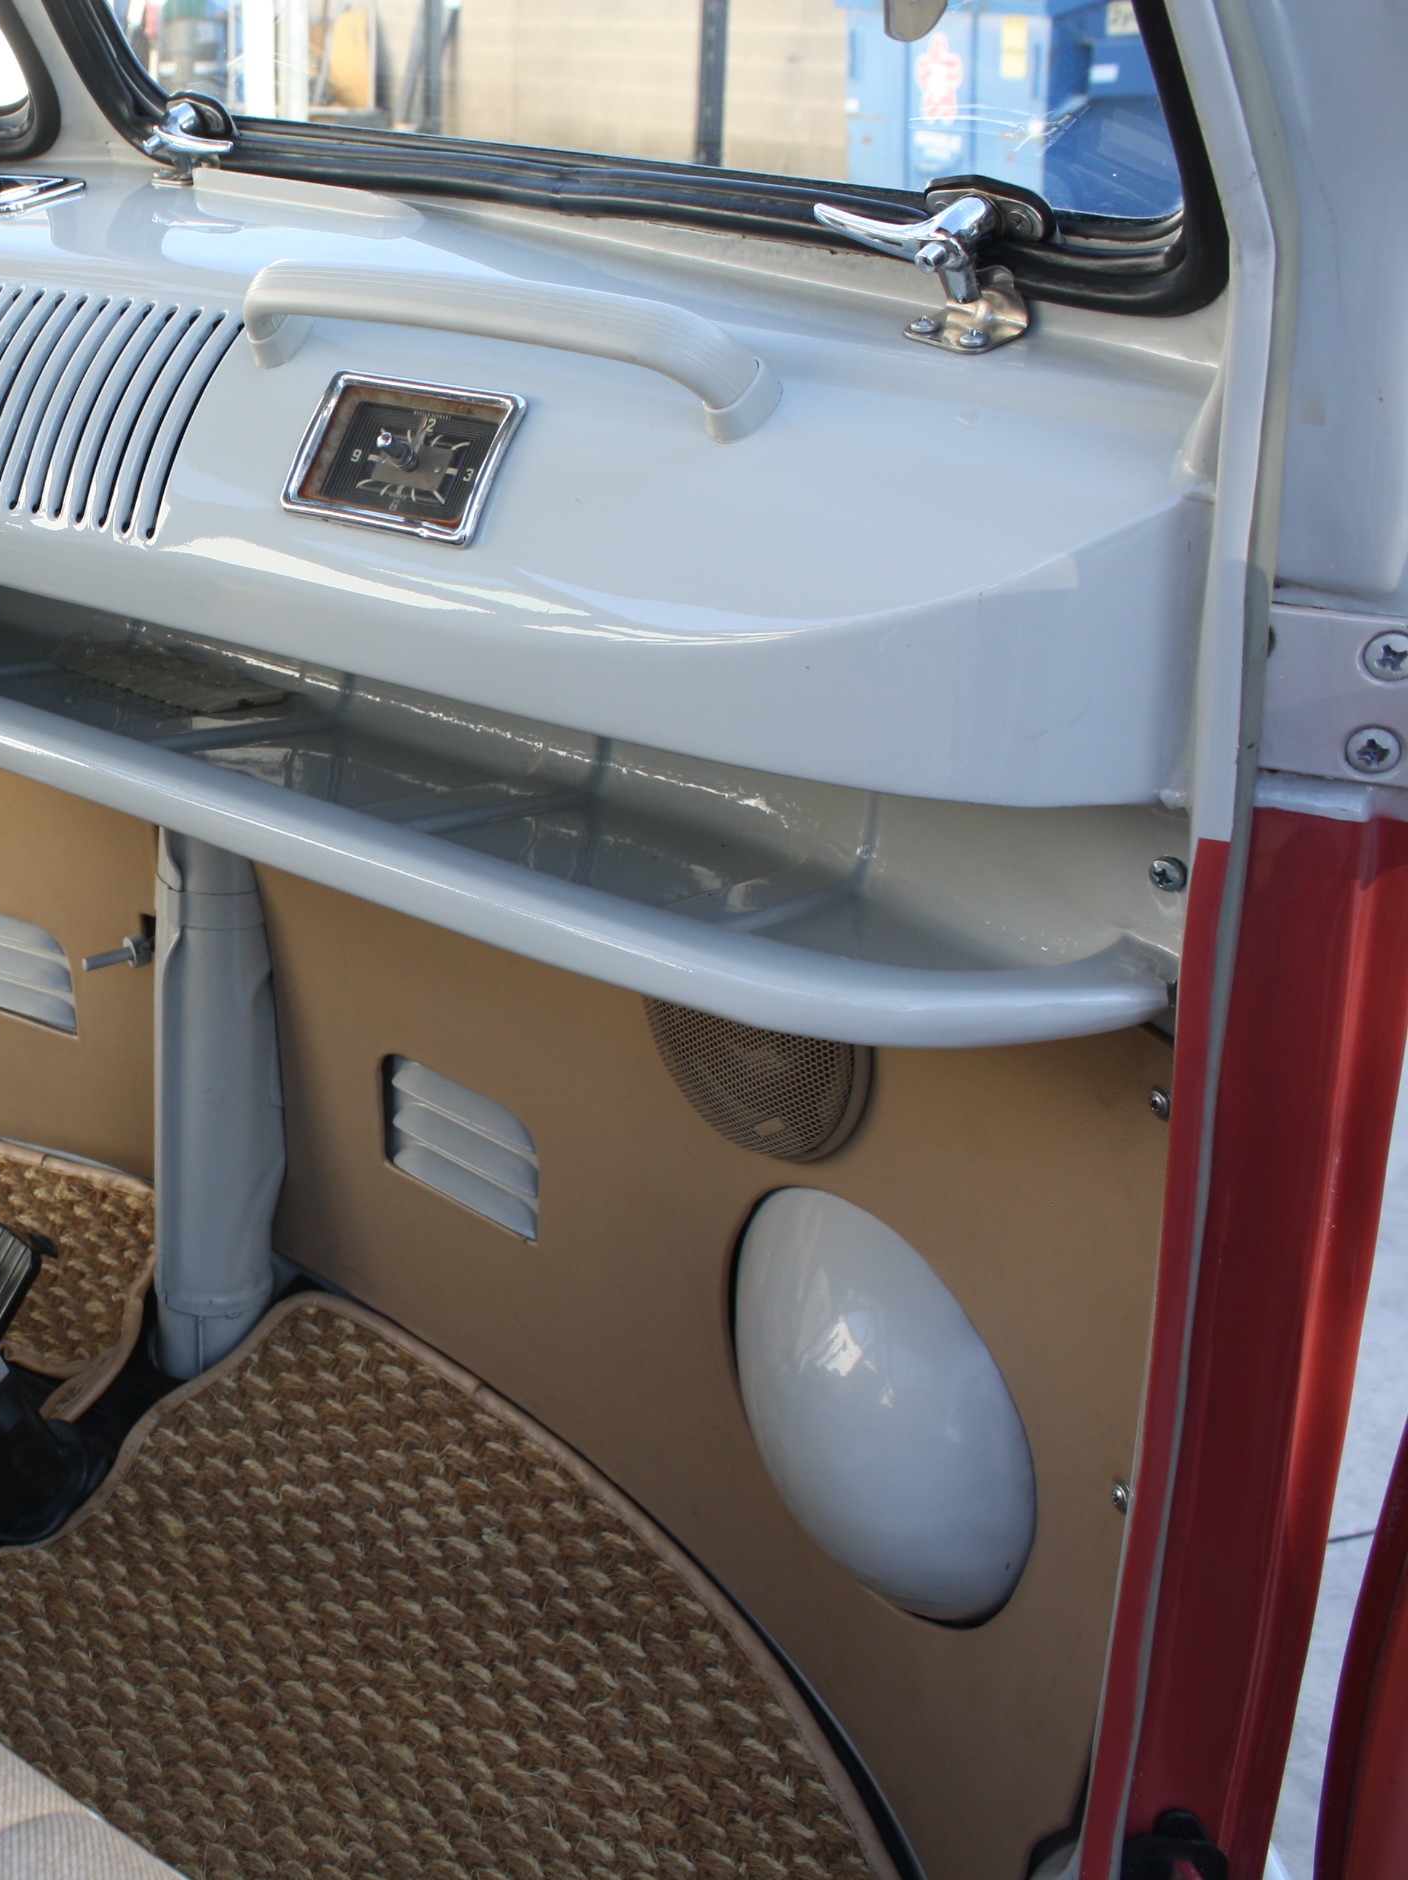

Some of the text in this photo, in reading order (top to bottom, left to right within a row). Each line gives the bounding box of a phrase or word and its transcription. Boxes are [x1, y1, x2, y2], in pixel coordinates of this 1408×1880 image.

[423, 418, 436, 432] 12
[351, 449, 362, 462] 9
[463, 468, 474, 481] 3
[389, 499, 400, 511] 6
